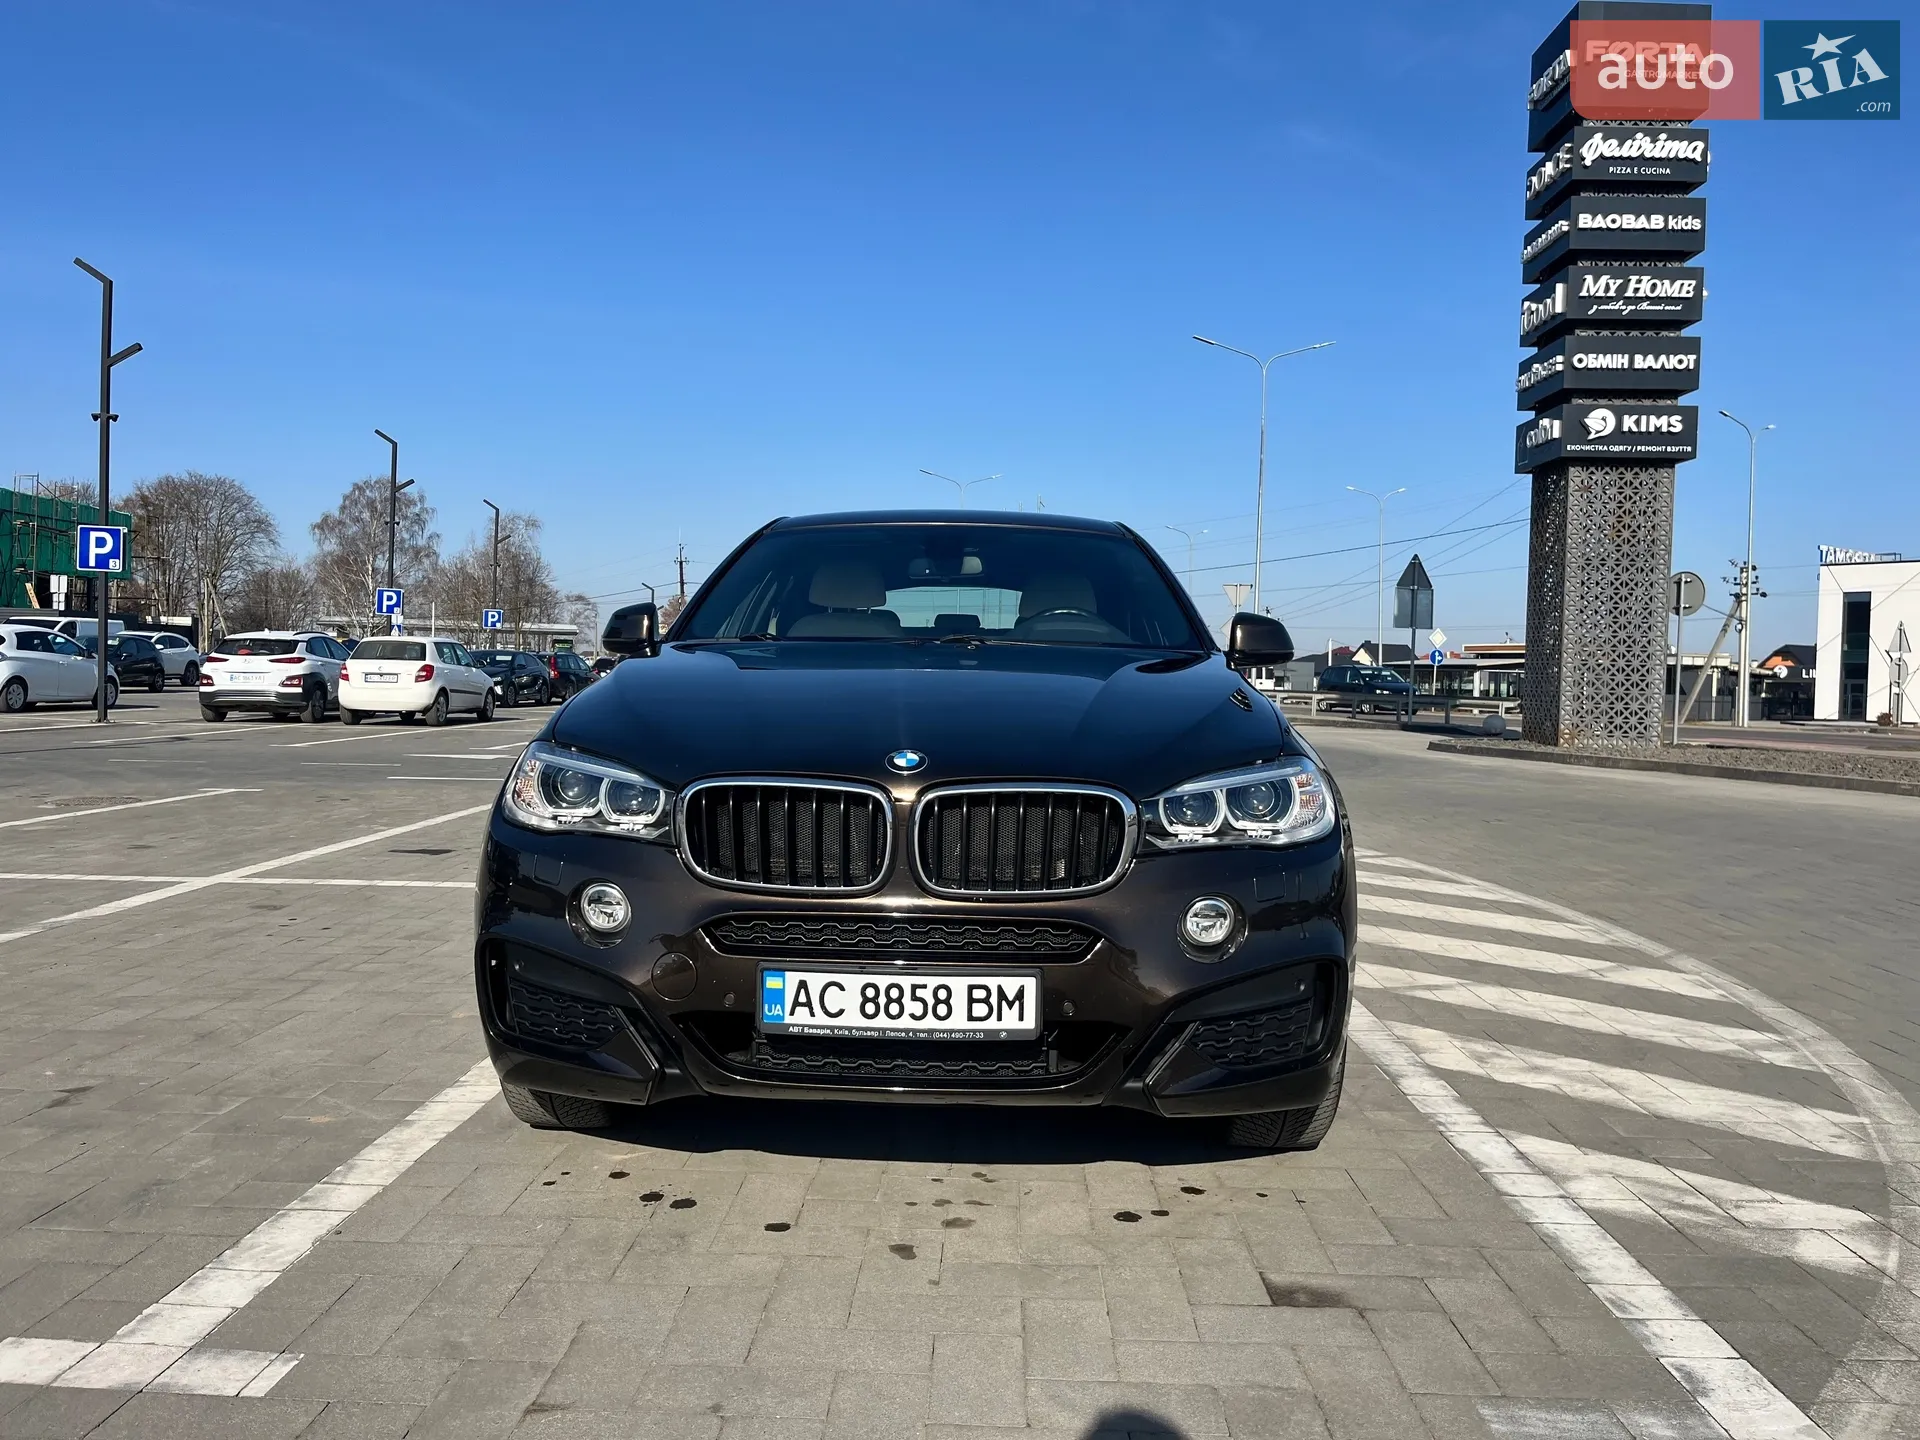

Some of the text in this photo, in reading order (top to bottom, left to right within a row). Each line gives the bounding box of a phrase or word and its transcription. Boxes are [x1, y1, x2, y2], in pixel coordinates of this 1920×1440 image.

[1609, 166, 1631, 174] PIZZA
[1640, 167, 1671, 175] CUCINA
[1577, 213, 1702, 230] BAOBAB kids
[1572, 353, 1697, 370] ОБМІН ВАЛЮТ
[1622, 414, 1683, 433] KIMS
[89, 531, 114, 567] P
[111, 560, 117, 568] 3
[382, 591, 397, 613] P
[488, 611, 499, 627] P
[788, 979, 1025, 1023] AC 8858 BM
[765, 1003, 783, 1017] UA
[851, 1028, 879, 1037] бульвар
[932, 1031, 950, 1040] (044)
[951, 1031, 984, 1039] 490-77-33
